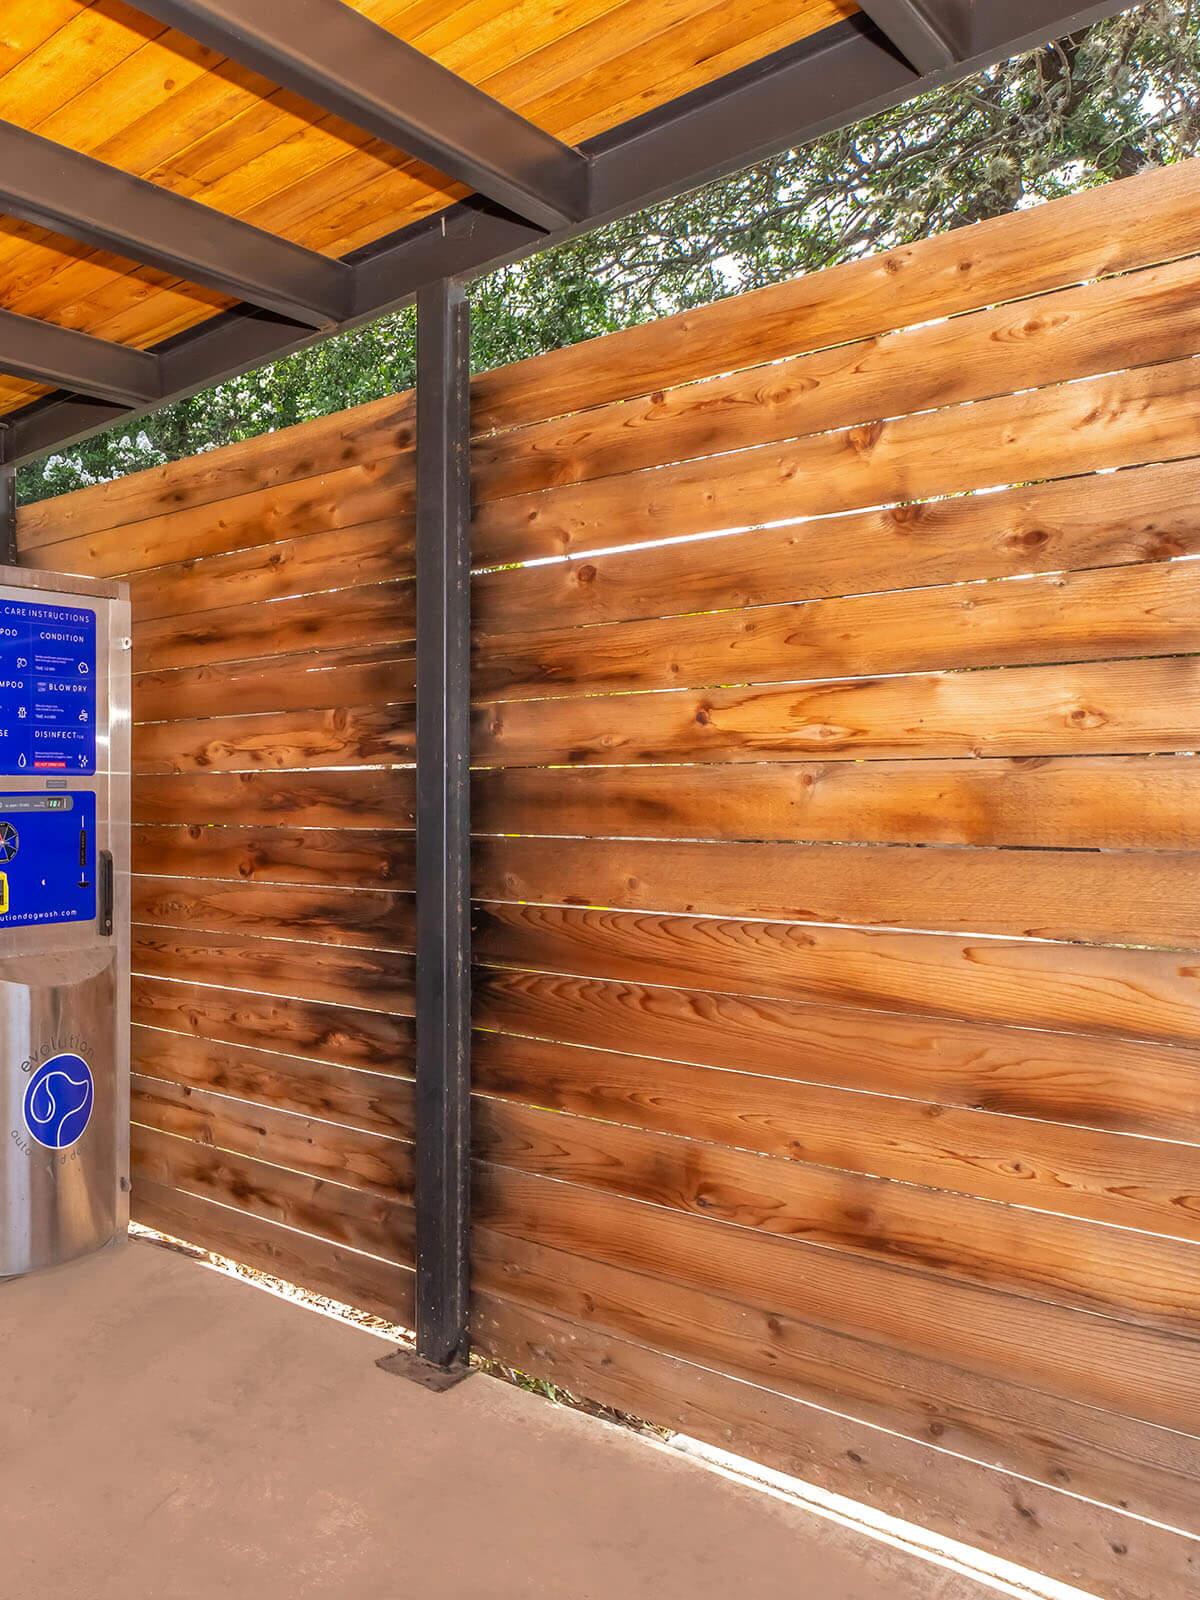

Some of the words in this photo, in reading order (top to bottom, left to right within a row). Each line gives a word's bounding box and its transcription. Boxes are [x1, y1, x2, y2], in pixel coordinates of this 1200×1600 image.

[4, 606, 26, 616] CARE
[29, 609, 90, 623] INSTRUCTIONS
[40, 632, 84, 643] CONDITION
[48, 683, 71, 692] BLOW
[72, 685, 87, 693] DRY
[34, 730, 76, 739] DISINFECT
[21, 1034, 95, 1073] evolution
